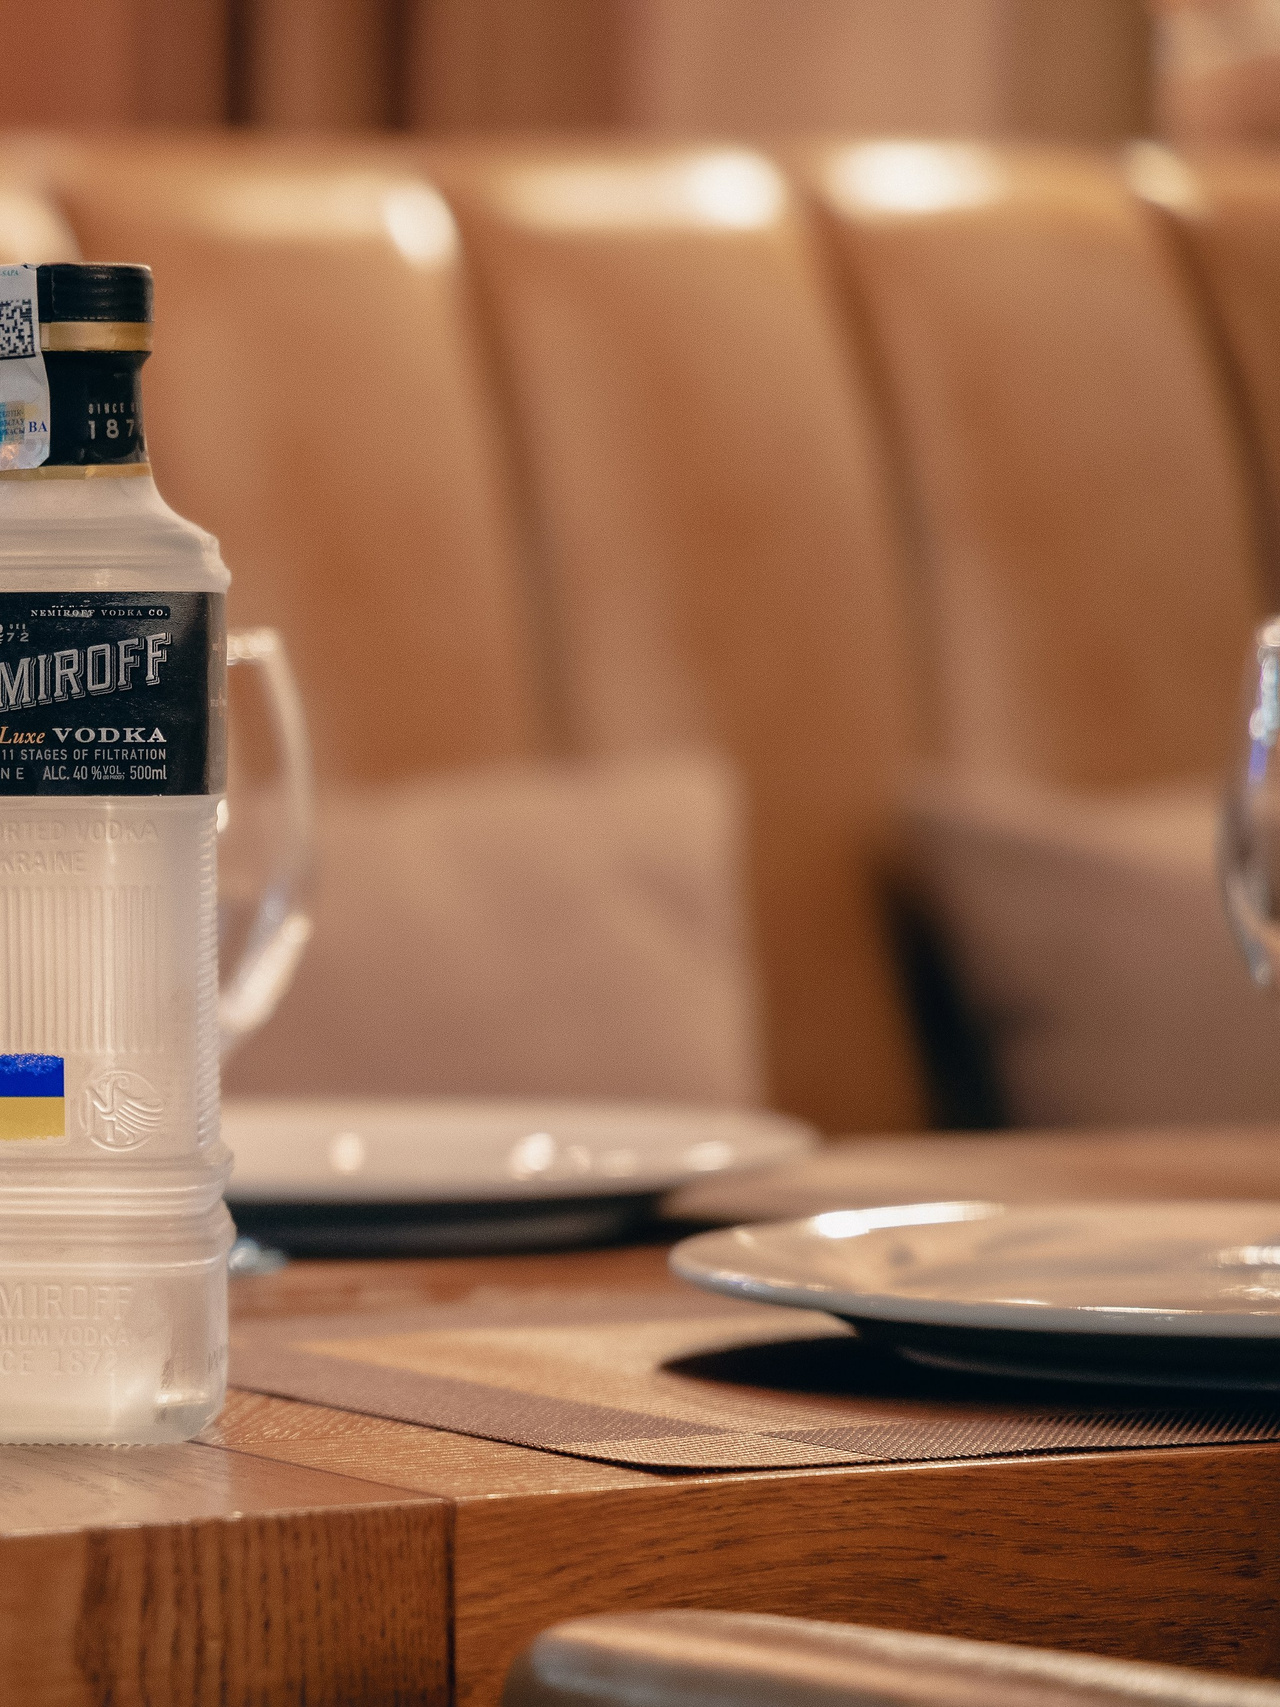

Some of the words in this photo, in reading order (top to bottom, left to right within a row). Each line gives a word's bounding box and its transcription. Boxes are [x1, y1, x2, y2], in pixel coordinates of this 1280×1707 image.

[88, 403, 124, 414] SINCE
[28, 421, 48, 433] BA
[30, 609, 95, 618] NEMIROFF
[101, 609, 142, 617] VODKA
[148, 609, 168, 617] CO.
[51, 727, 167, 743] VODKA
[1, 749, 14, 761] 11
[20, 748, 68, 761] STAGES
[73, 748, 88, 761] OF
[94, 748, 167, 761] FILTRATION
[42, 765, 69, 780] ALC.
[73, 765, 88, 780] 40
[129, 764, 167, 780] 500ml
[72, 820, 159, 842] VODKA
[55, 1326, 133, 1347] VODKA
